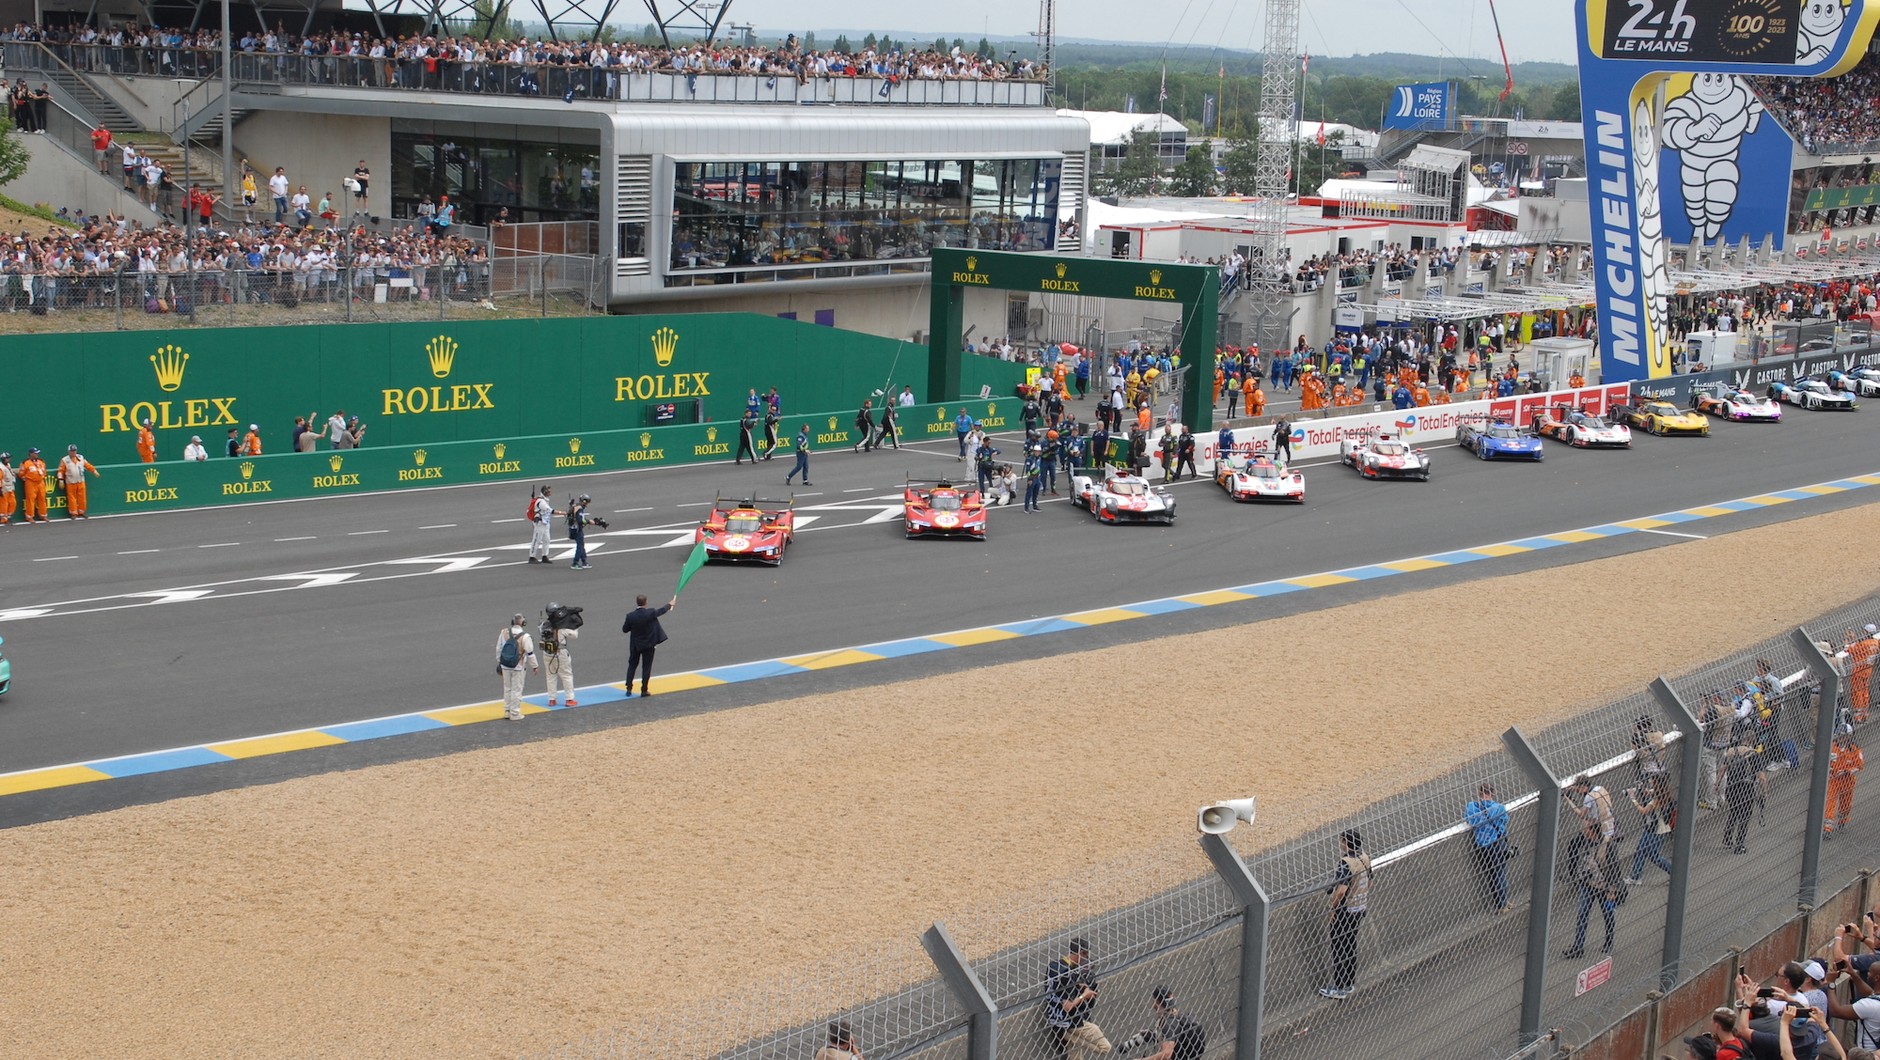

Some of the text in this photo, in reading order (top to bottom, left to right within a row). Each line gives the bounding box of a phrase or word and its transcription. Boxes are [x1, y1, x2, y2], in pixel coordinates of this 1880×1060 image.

[1618, 0, 1696, 39] 24h
[1726, 15, 1765, 34] 100
[1769, 18, 1786, 26] 1923
[1767, 26, 1786, 34] 2023
[1613, 39, 1689, 53] LE MANS
[1418, 93, 1442, 104] PAYS
[1414, 108, 1441, 118] LOIRE
[1595, 110, 1640, 366] MICHELIN
[953, 272, 989, 285] ROLEX
[1041, 279, 1080, 292] ROLEX
[1135, 286, 1176, 299] ROLEX
[1811, 360, 1838, 376] CASTORE
[1757, 368, 1787, 384] CASTORE
[615, 372, 711, 402] ROLEX
[1660, 387, 1676, 397] MANS
[382, 383, 495, 415] ROLEX
[99, 397, 239, 433] ROLEX
[927, 422, 956, 433] ROLEX
[817, 431, 849, 444] ROLEX
[627, 448, 664, 462] ROLEX
[694, 442, 729, 455] ROLEX
[479, 460, 521, 474] ROLEX
[555, 454, 595, 468] ROLEX
[313, 473, 360, 488] ROLEX
[398, 466, 443, 481] ROLEX
[223, 480, 272, 495] ROLEX
[126, 487, 179, 503] ROLEX
